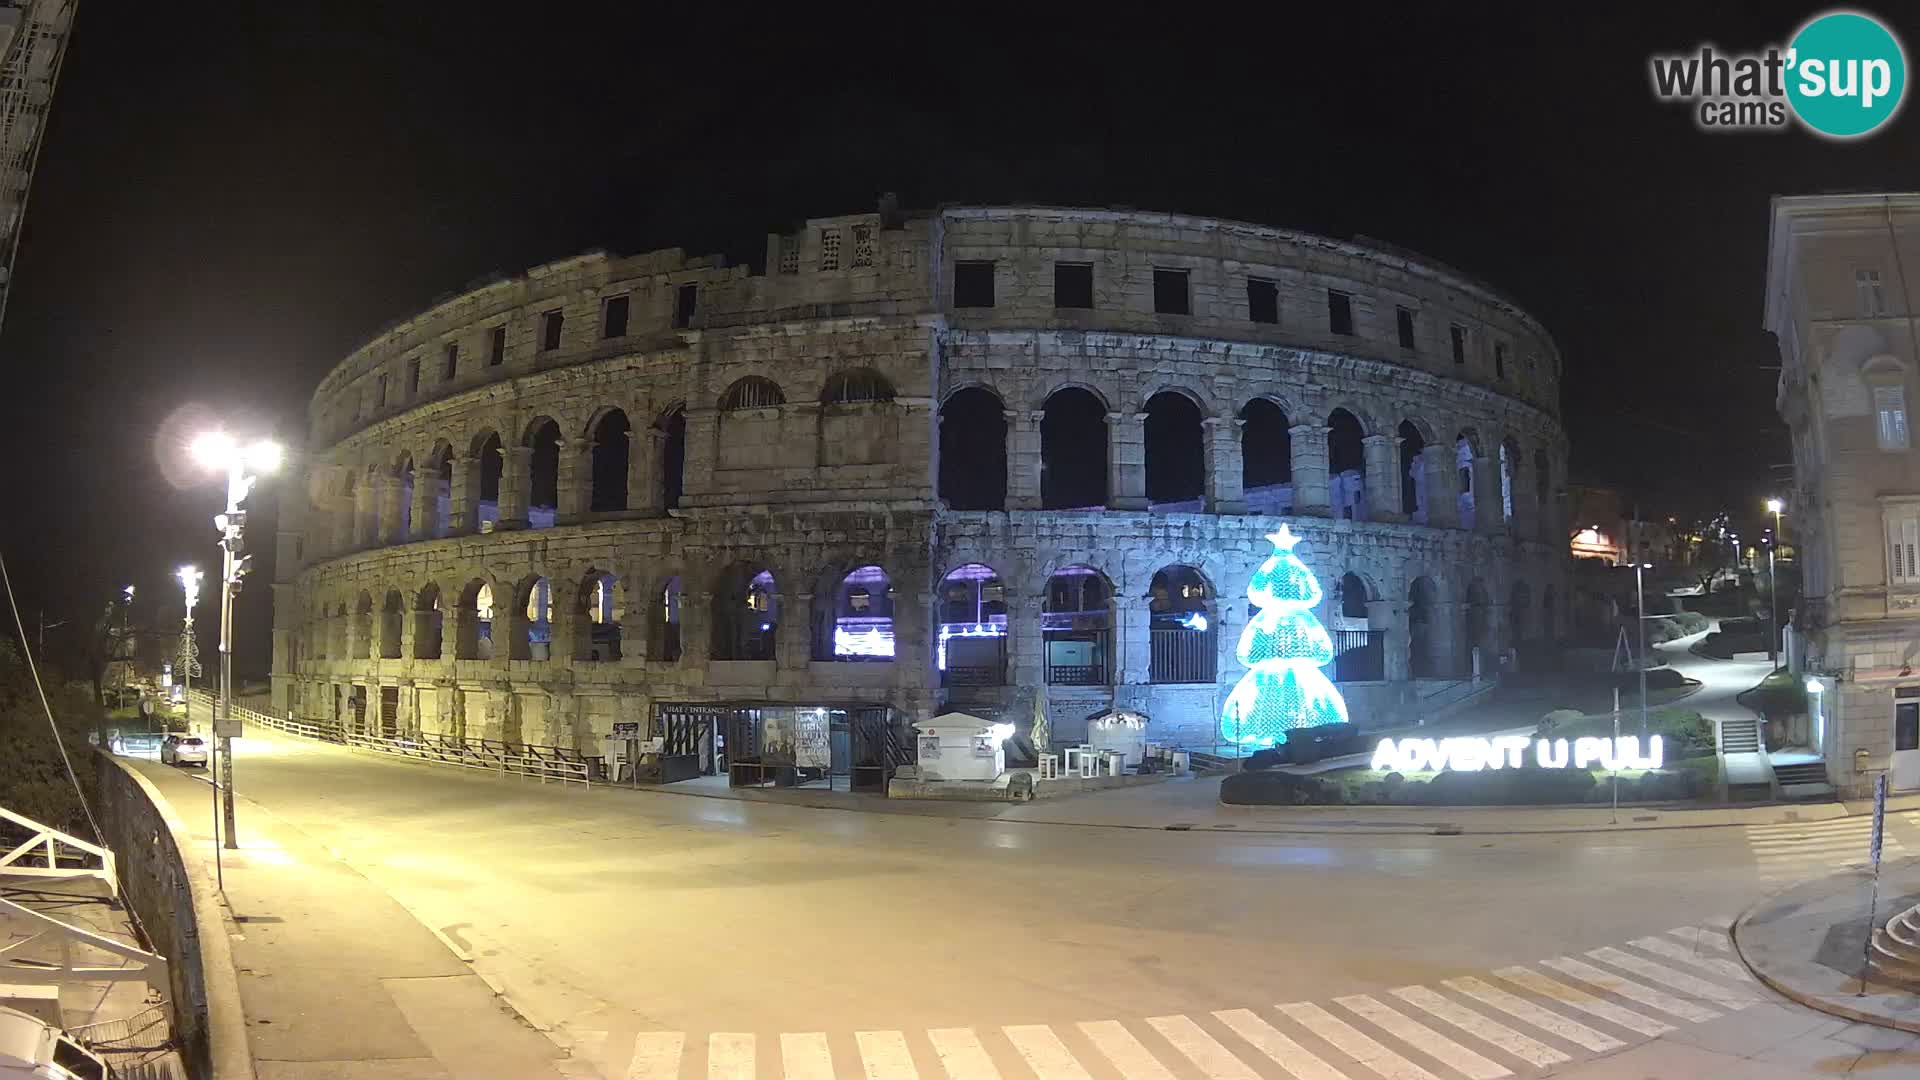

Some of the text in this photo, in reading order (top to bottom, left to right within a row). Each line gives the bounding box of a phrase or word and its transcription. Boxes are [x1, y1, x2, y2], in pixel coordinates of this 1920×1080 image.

[1370, 734, 1664, 772] ADVENT U PULI
